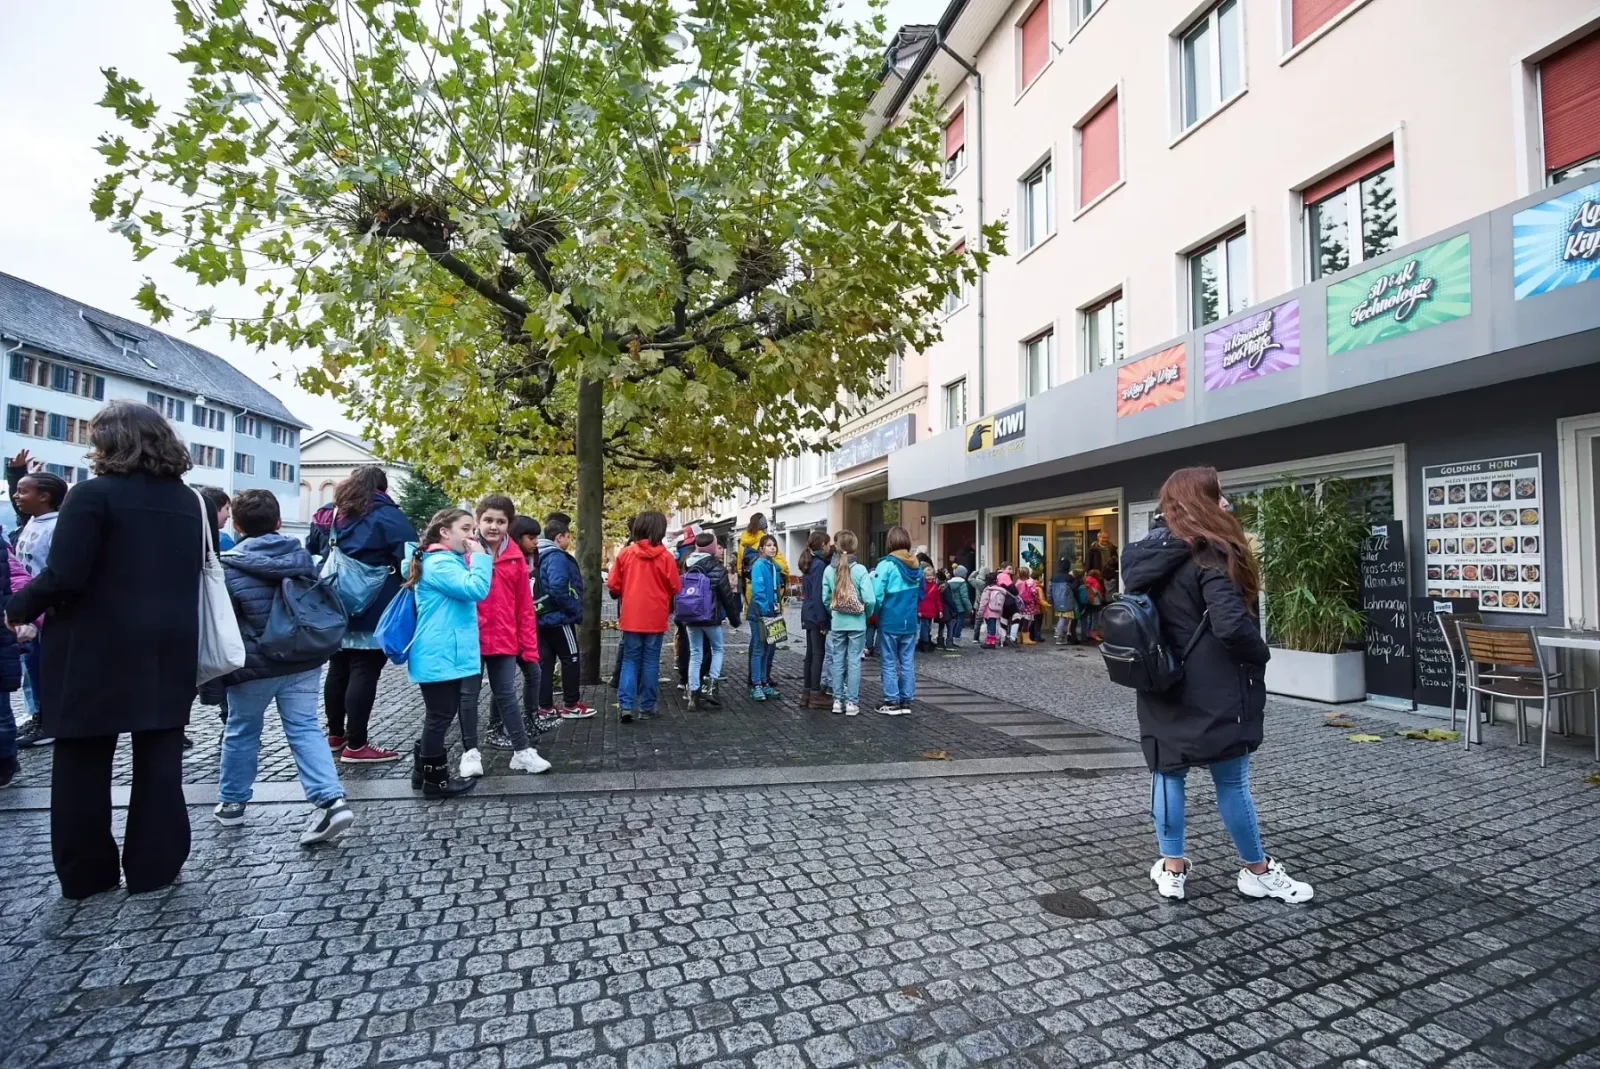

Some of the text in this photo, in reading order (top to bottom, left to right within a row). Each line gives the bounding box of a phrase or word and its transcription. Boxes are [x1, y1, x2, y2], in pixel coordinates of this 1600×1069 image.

[1369, 276, 1388, 299] 3D
[1350, 278, 1433, 326] Technologie
[994, 410, 1024, 439] KIWI
[1440, 459, 1518, 475] GOLDENES HORN
[1391, 612, 1406, 628] 18
